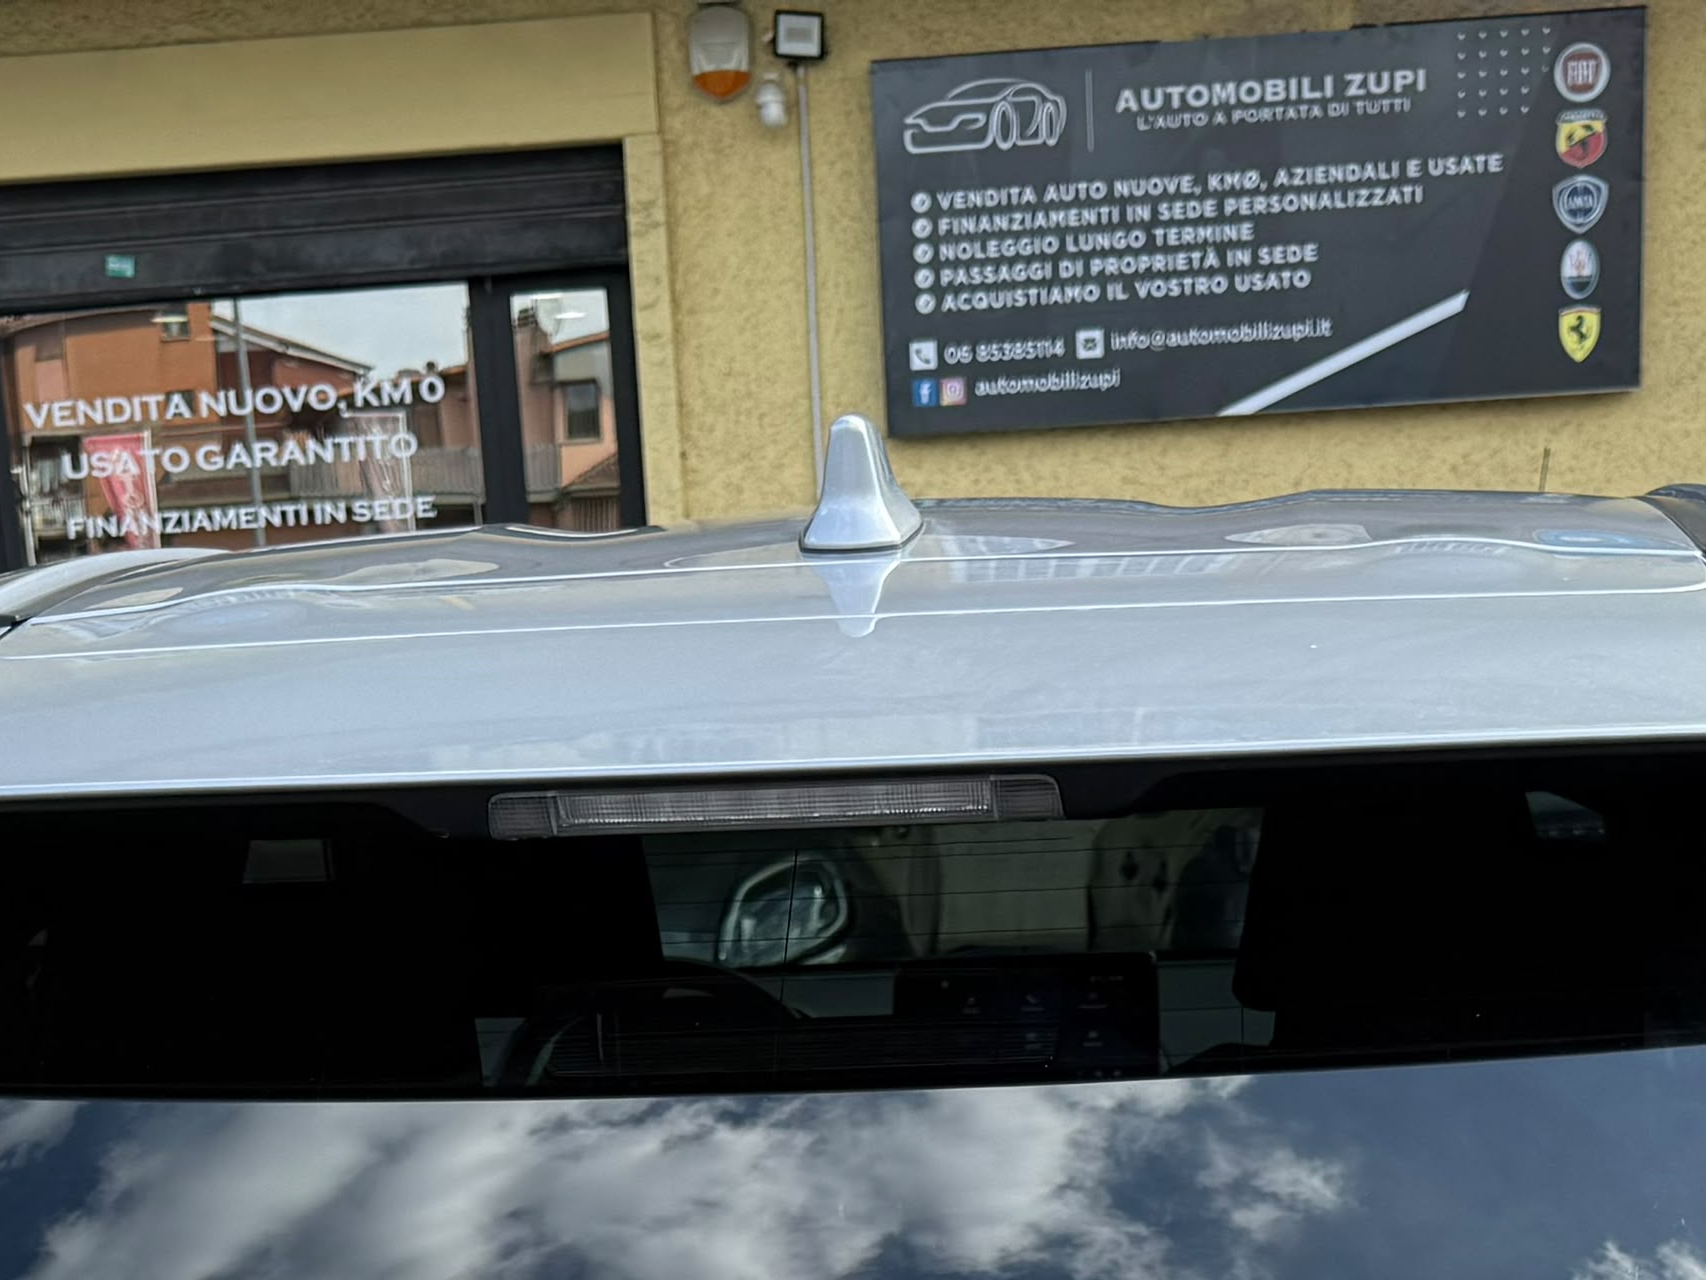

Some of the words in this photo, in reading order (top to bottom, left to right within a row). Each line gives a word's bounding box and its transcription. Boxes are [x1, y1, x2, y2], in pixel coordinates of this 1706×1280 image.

[1116, 75, 1334, 112] AUTOMOBILI
[1343, 68, 1427, 97] ZUPI
[1137, 112, 1209, 131] L'AUTO
[1213, 111, 1226, 126] A
[1231, 103, 1323, 124] PORTATA
[1328, 101, 1349, 118] DI
[1354, 98, 1411, 115] TUTTI
[936, 184, 1037, 211] VENDITA
[1043, 179, 1108, 202] AUTO
[1113, 174, 1202, 198] NUOVE,
[1273, 160, 1400, 188] AZIENDALI
[1406, 158, 1423, 178] E
[1427, 153, 1504, 176] USATE
[938, 206, 1120, 236] FINANZIAMENTI
[1126, 203, 1151, 223] IN
[1157, 199, 1218, 221] SEDE
[1224, 185, 1424, 216] PERSONALIZZATI
[938, 234, 1060, 261] NOLEGGIO
[1065, 229, 1146, 252] LUNGO
[1152, 221, 1254, 247] TERMINE
[939, 260, 1052, 287] PASSAGGI
[1058, 258, 1084, 279] DI
[1089, 247, 1220, 276] PROPRIETÀ
[1226, 248, 1251, 268] IN
[1258, 243, 1318, 265] SEDE
[941, 282, 1101, 312] ACQUISTIAMO
[1106, 280, 1130, 301] IL
[1134, 275, 1228, 299] VOSTRO
[1234, 268, 1312, 293] USATO
[24, 393, 192, 429] VENDITA
[200, 383, 348, 418] NUOVO,
[353, 377, 412, 408] KM
[62, 447, 190, 480] USATO
[196, 432, 419, 472] GARANTITO
[67, 501, 309, 540] FINANZIAMENTI
[313, 500, 348, 526] IN
[352, 495, 437, 523] SEDE
